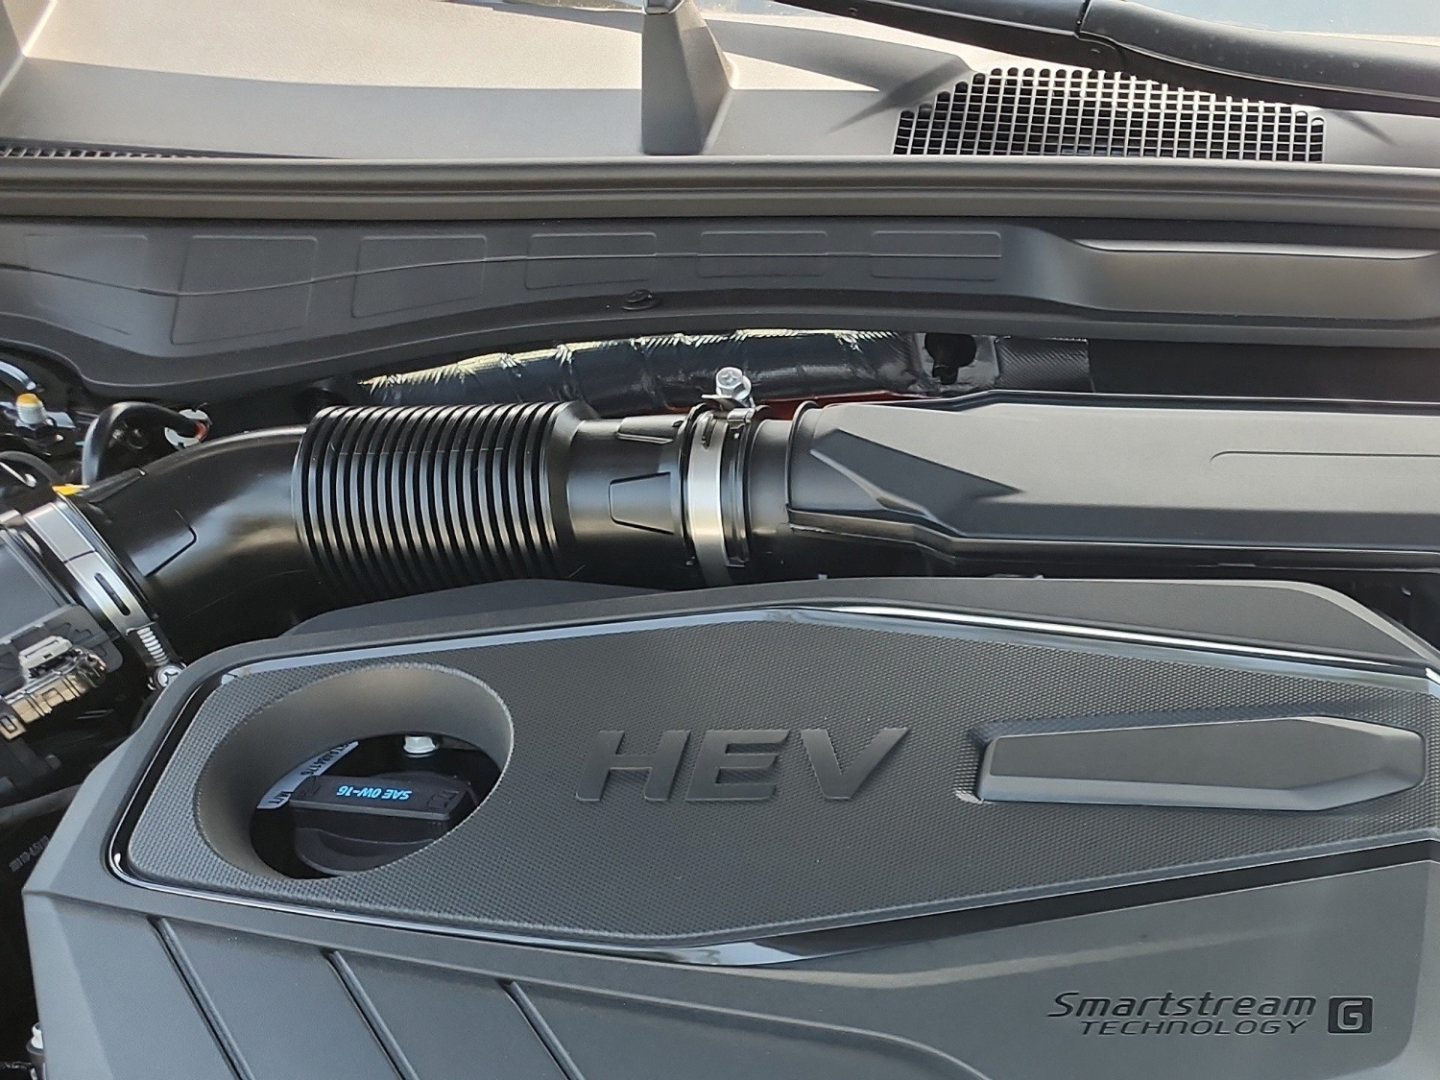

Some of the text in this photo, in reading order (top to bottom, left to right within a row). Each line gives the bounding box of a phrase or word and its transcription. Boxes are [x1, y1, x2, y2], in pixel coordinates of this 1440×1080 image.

[575, 727, 910, 802] HEV
[336, 785, 413, 801] SAE 0W-16
[1047, 991, 1368, 1032] Smartstream G
[1080, 1020, 1308, 1036] TECHNOLOGY
